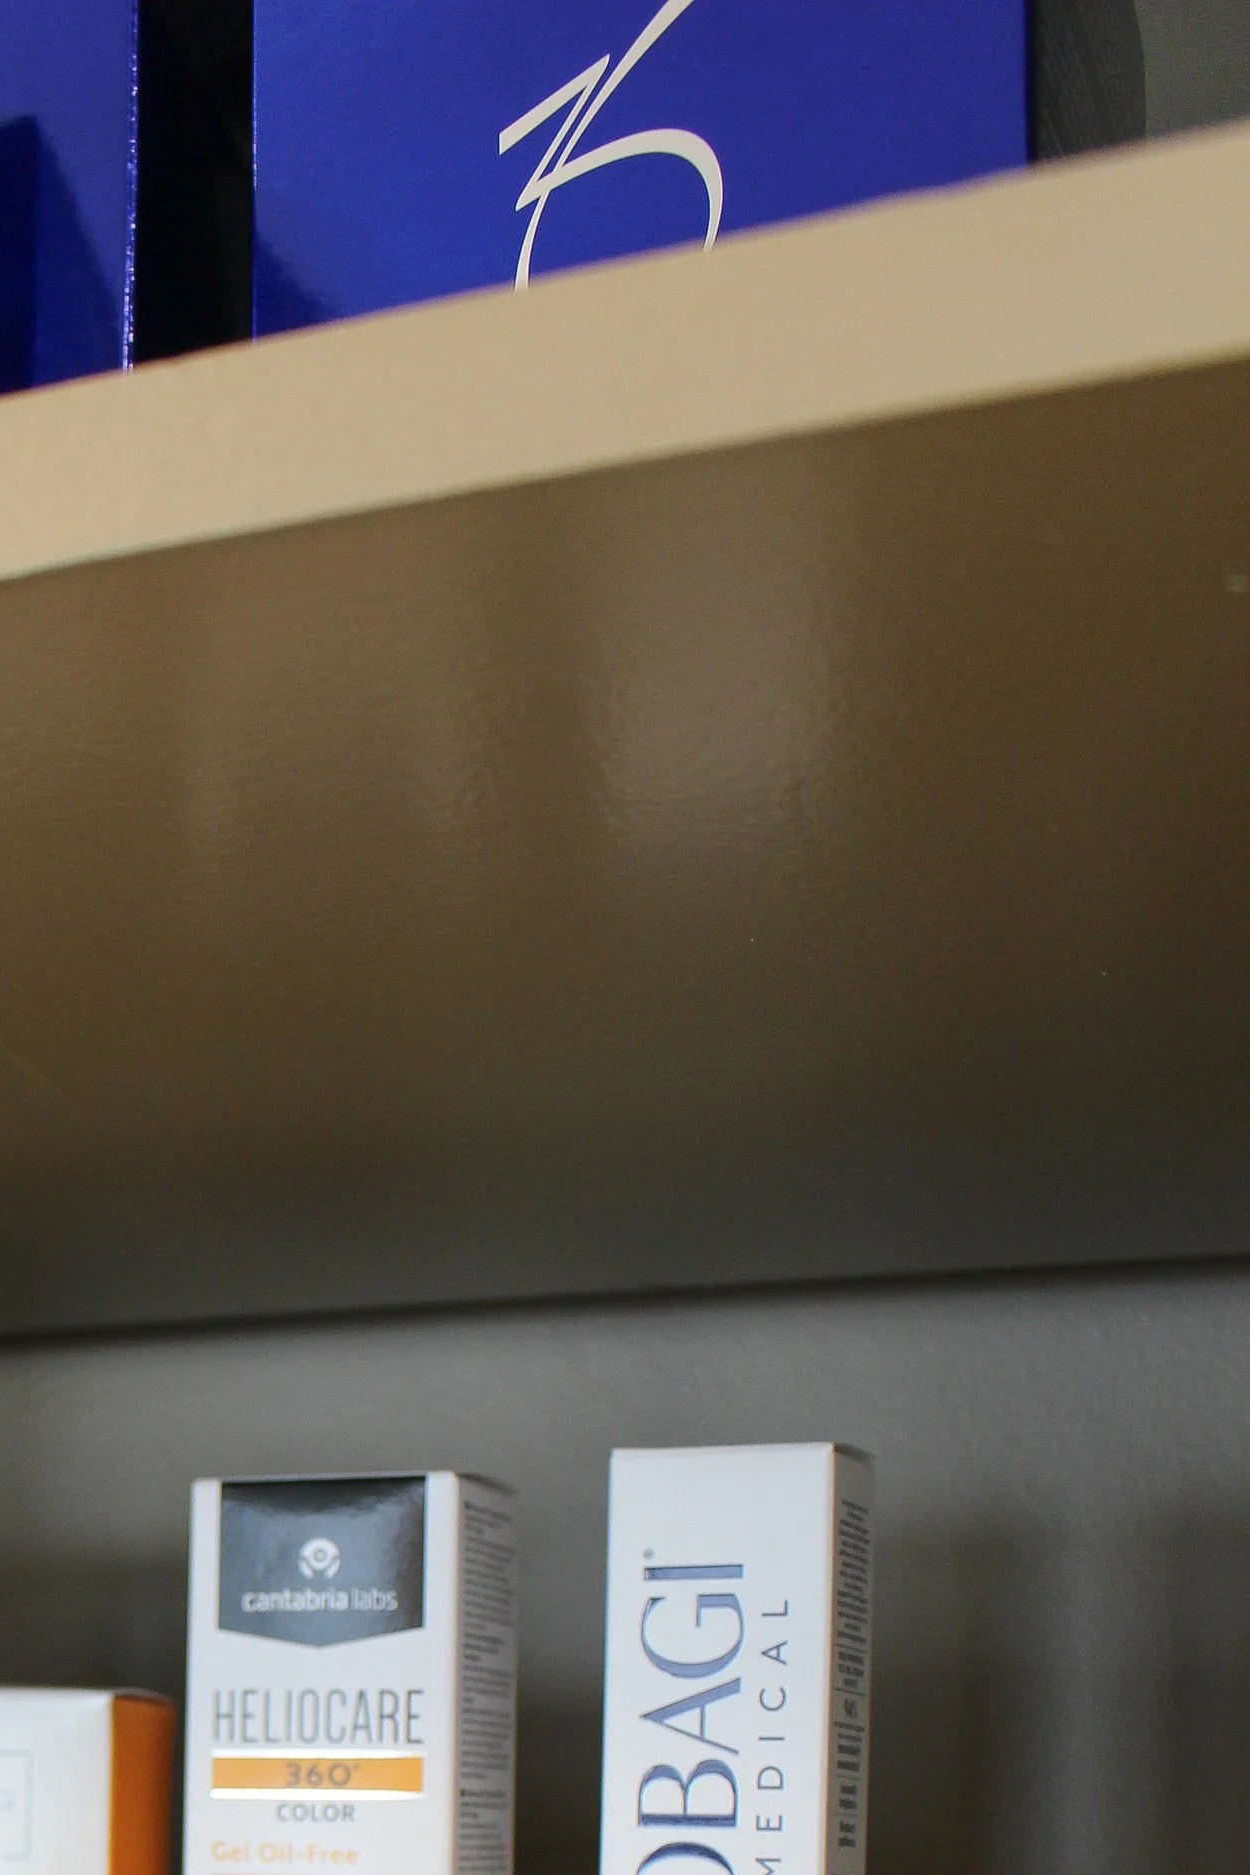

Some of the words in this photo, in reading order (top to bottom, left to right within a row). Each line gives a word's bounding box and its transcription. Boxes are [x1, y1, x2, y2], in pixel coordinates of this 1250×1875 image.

[241, 1588, 349, 1612] cantabria
[352, 1588, 399, 1612] labs
[213, 1688, 425, 1744] HELIOCARE
[276, 1803, 356, 1823] COLOR
[210, 1841, 250, 1863] Gel
[258, 1842, 360, 1866] Oil-Free
